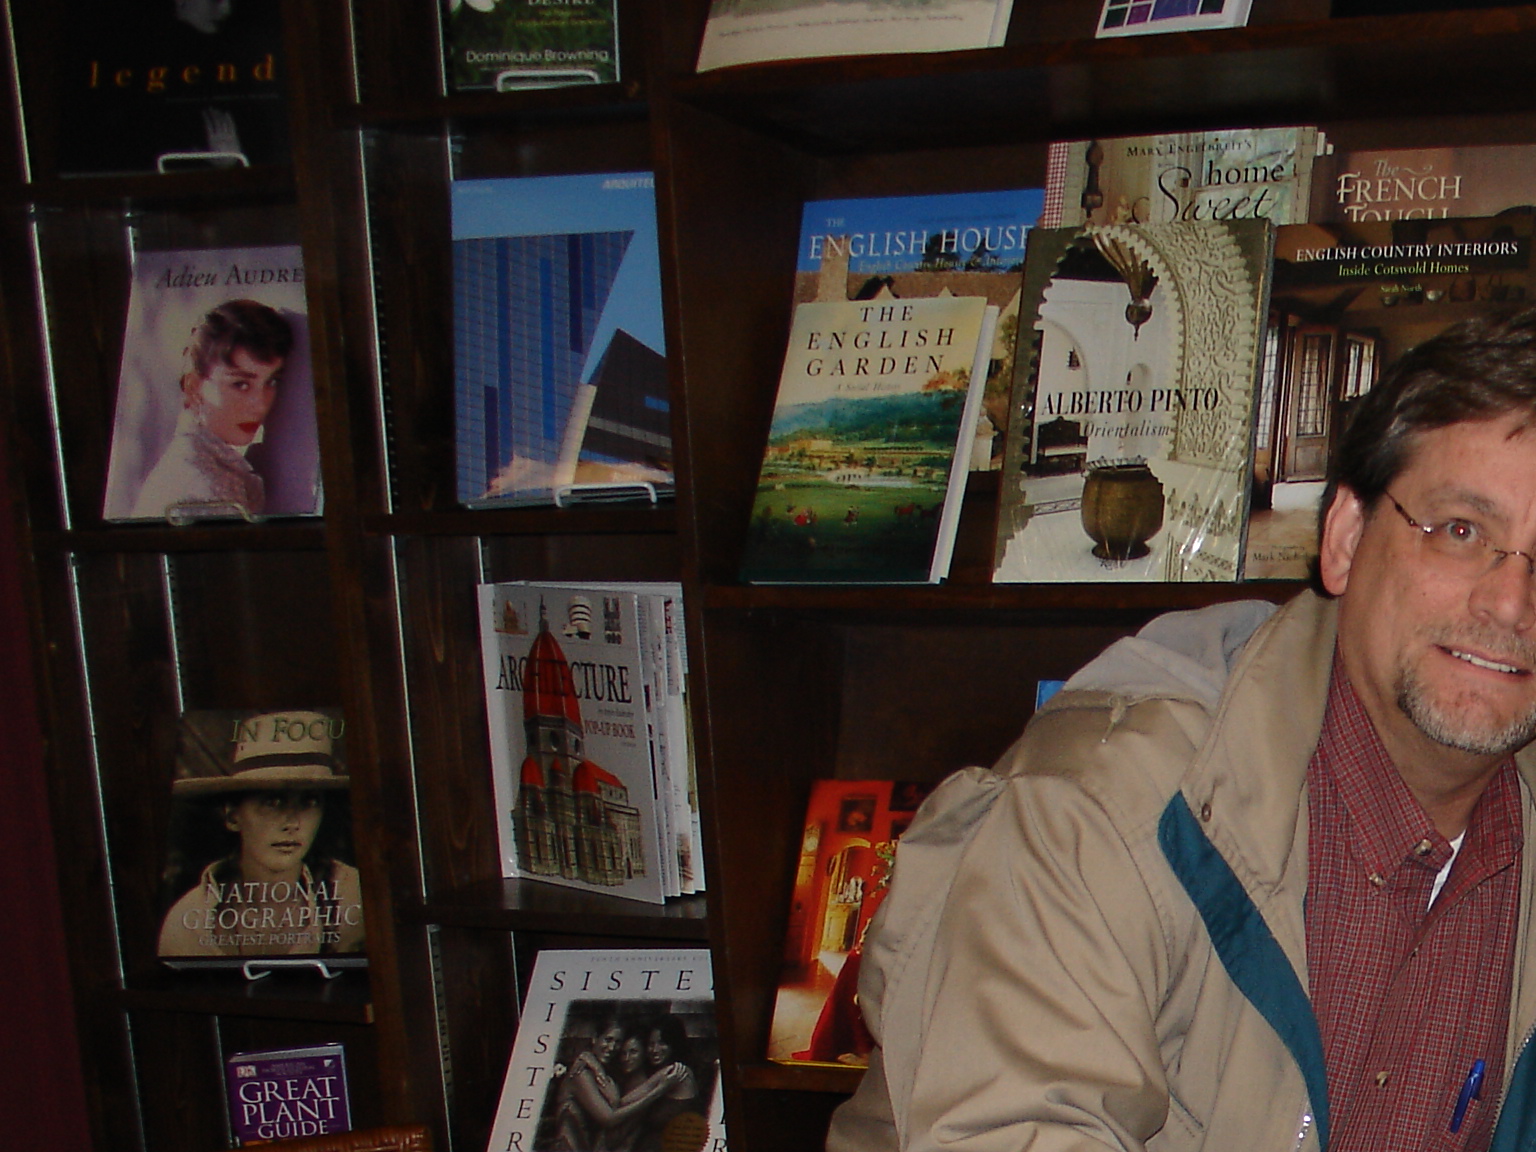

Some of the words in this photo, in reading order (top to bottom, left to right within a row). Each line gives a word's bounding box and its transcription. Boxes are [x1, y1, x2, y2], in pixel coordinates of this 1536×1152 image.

[466, 50, 542, 64] Dominique
[545, 49, 609, 64] Browning
[89, 54, 275, 92] legend
[1208, 160, 1285, 185] home
[1132, 166, 1276, 223] Sweet
[1337, 171, 1462, 204] FRENCH
[810, 230, 927, 260] ENGLISH
[1296, 247, 1357, 262] ENGLISH
[1361, 244, 1433, 259] COUNTRY
[1437, 242, 1518, 257] INTERIORS
[156, 265, 217, 288] Adieu
[1338, 264, 1370, 277] Inside
[1374, 263, 1426, 276] Cotswold
[1430, 262, 1469, 274] Homes
[860, 305, 914, 323] THE
[807, 328, 955, 350] ENGLISH
[806, 355, 944, 377] GARDEN
[1041, 390, 1142, 415] ALBERTO
[1150, 388, 1219, 412] PINTO
[1084, 421, 1170, 438] Orientalism
[231, 719, 259, 743] IN
[273, 718, 346, 743] FOCU
[206, 880, 345, 904] NATIONAL
[182, 904, 362, 930] GEOGRAPHIC
[269, 931, 341, 946] PORTRAITS
[550, 970, 714, 991] SISTE
[239, 1076, 337, 1103] GREAT
[242, 1097, 340, 1126] PLANT
[258, 1120, 329, 1139] GUIDE
